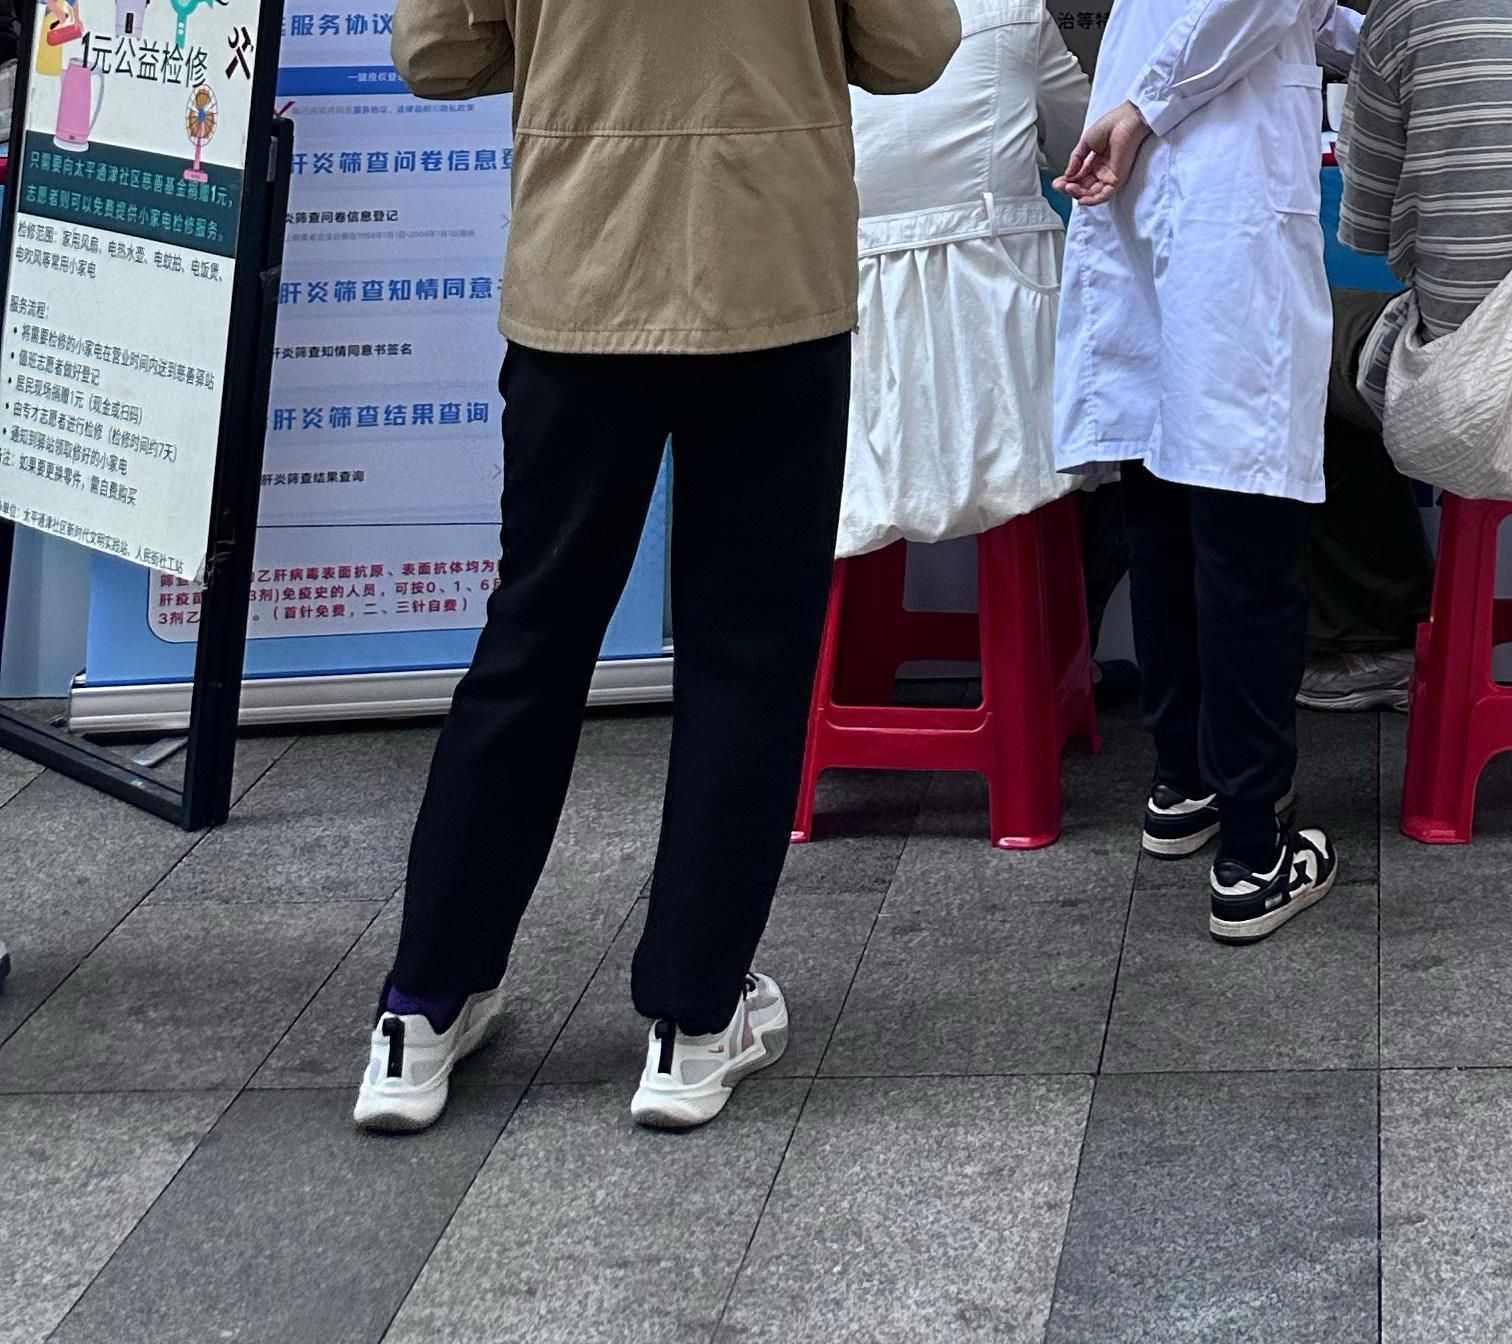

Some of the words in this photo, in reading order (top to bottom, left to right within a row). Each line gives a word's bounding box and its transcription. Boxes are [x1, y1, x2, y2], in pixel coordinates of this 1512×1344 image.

[281, 13, 393, 37] 服务协议
[81, 31, 209, 88] 1元公益检修
[279, 276, 502, 305] 肝炎筛查知情同意
[272, 401, 489, 432] 肝炎筛查结果查询
[251, 559, 499, 584] 乙肝病毒表面抗原、表面抗体均为
